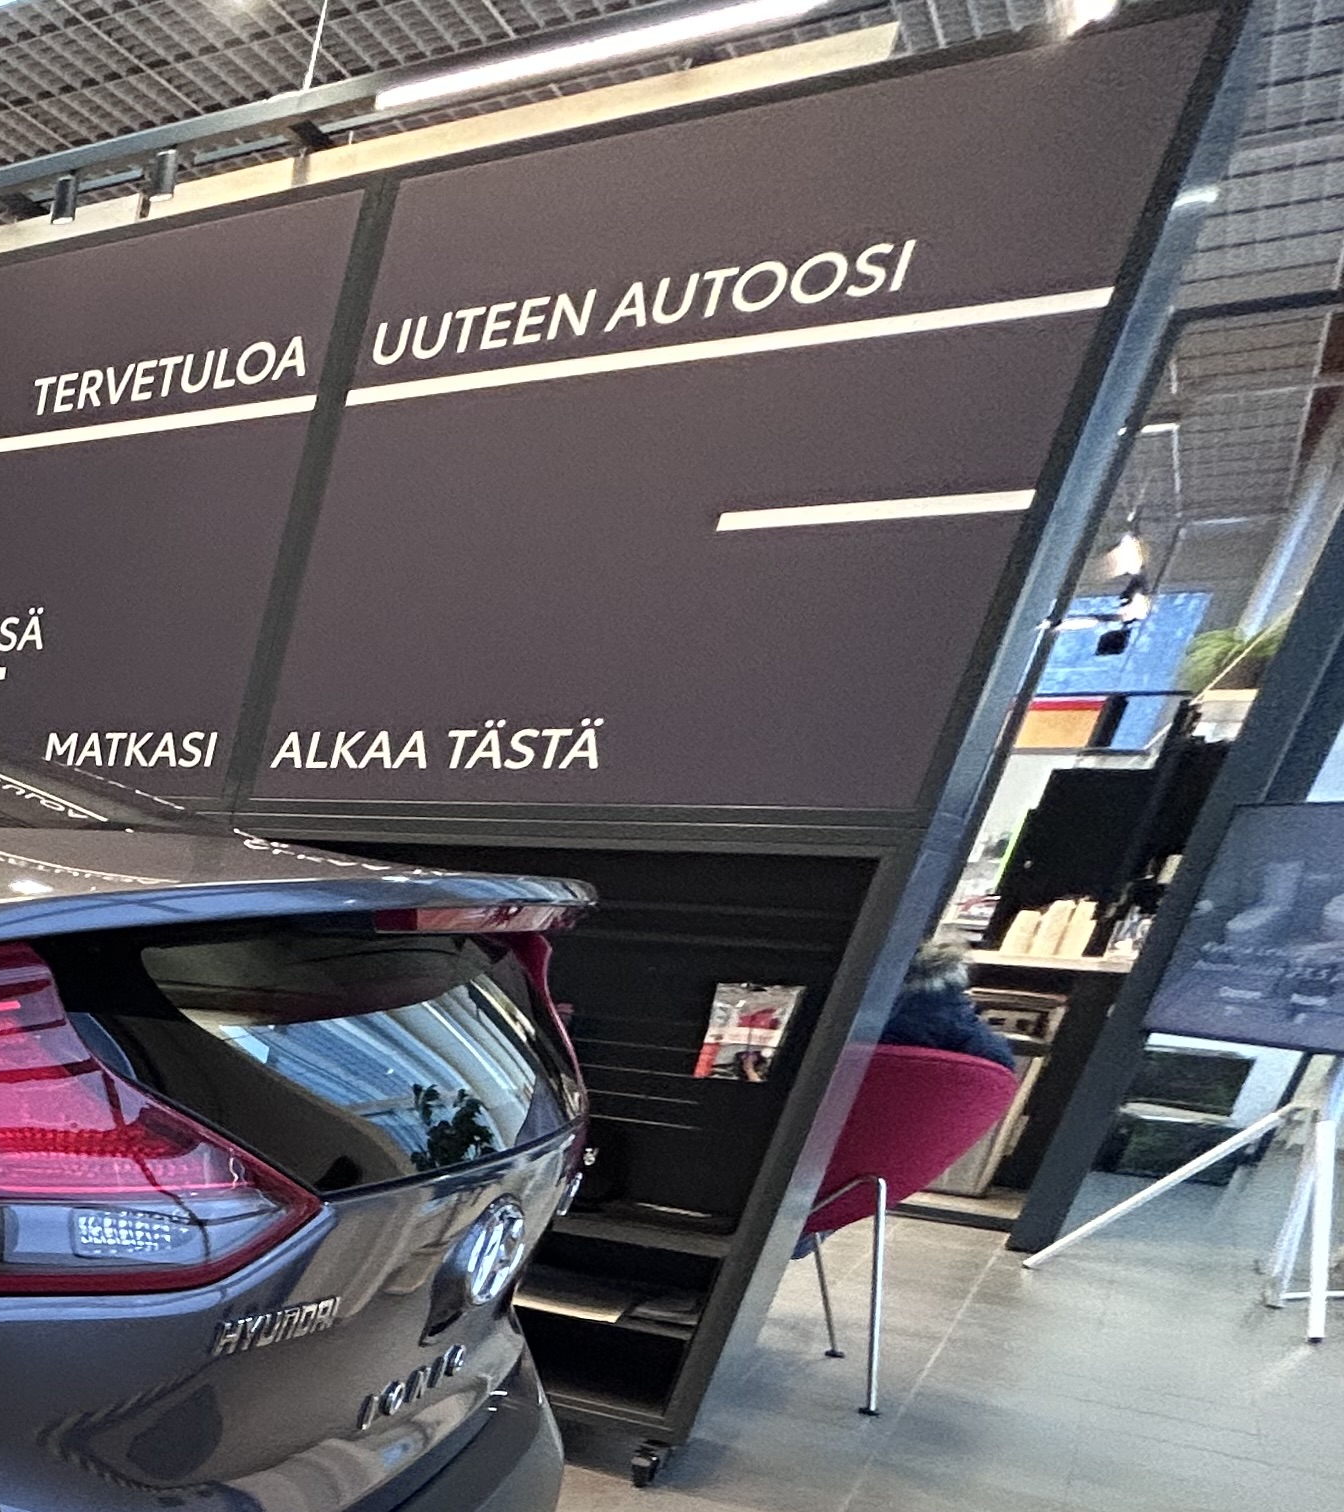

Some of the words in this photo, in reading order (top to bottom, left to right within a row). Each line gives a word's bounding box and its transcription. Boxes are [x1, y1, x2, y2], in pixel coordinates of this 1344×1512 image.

[33, 336, 308, 416] TERVETULOA
[372, 289, 597, 366] UUTEEN
[603, 240, 918, 334] AUTOOSI
[43, 732, 218, 768] MATKASI
[269, 731, 428, 769] ALKAA
[447, 717, 605, 770] TÄSTÄ
[213, 1296, 341, 1357] HYUNDAI
